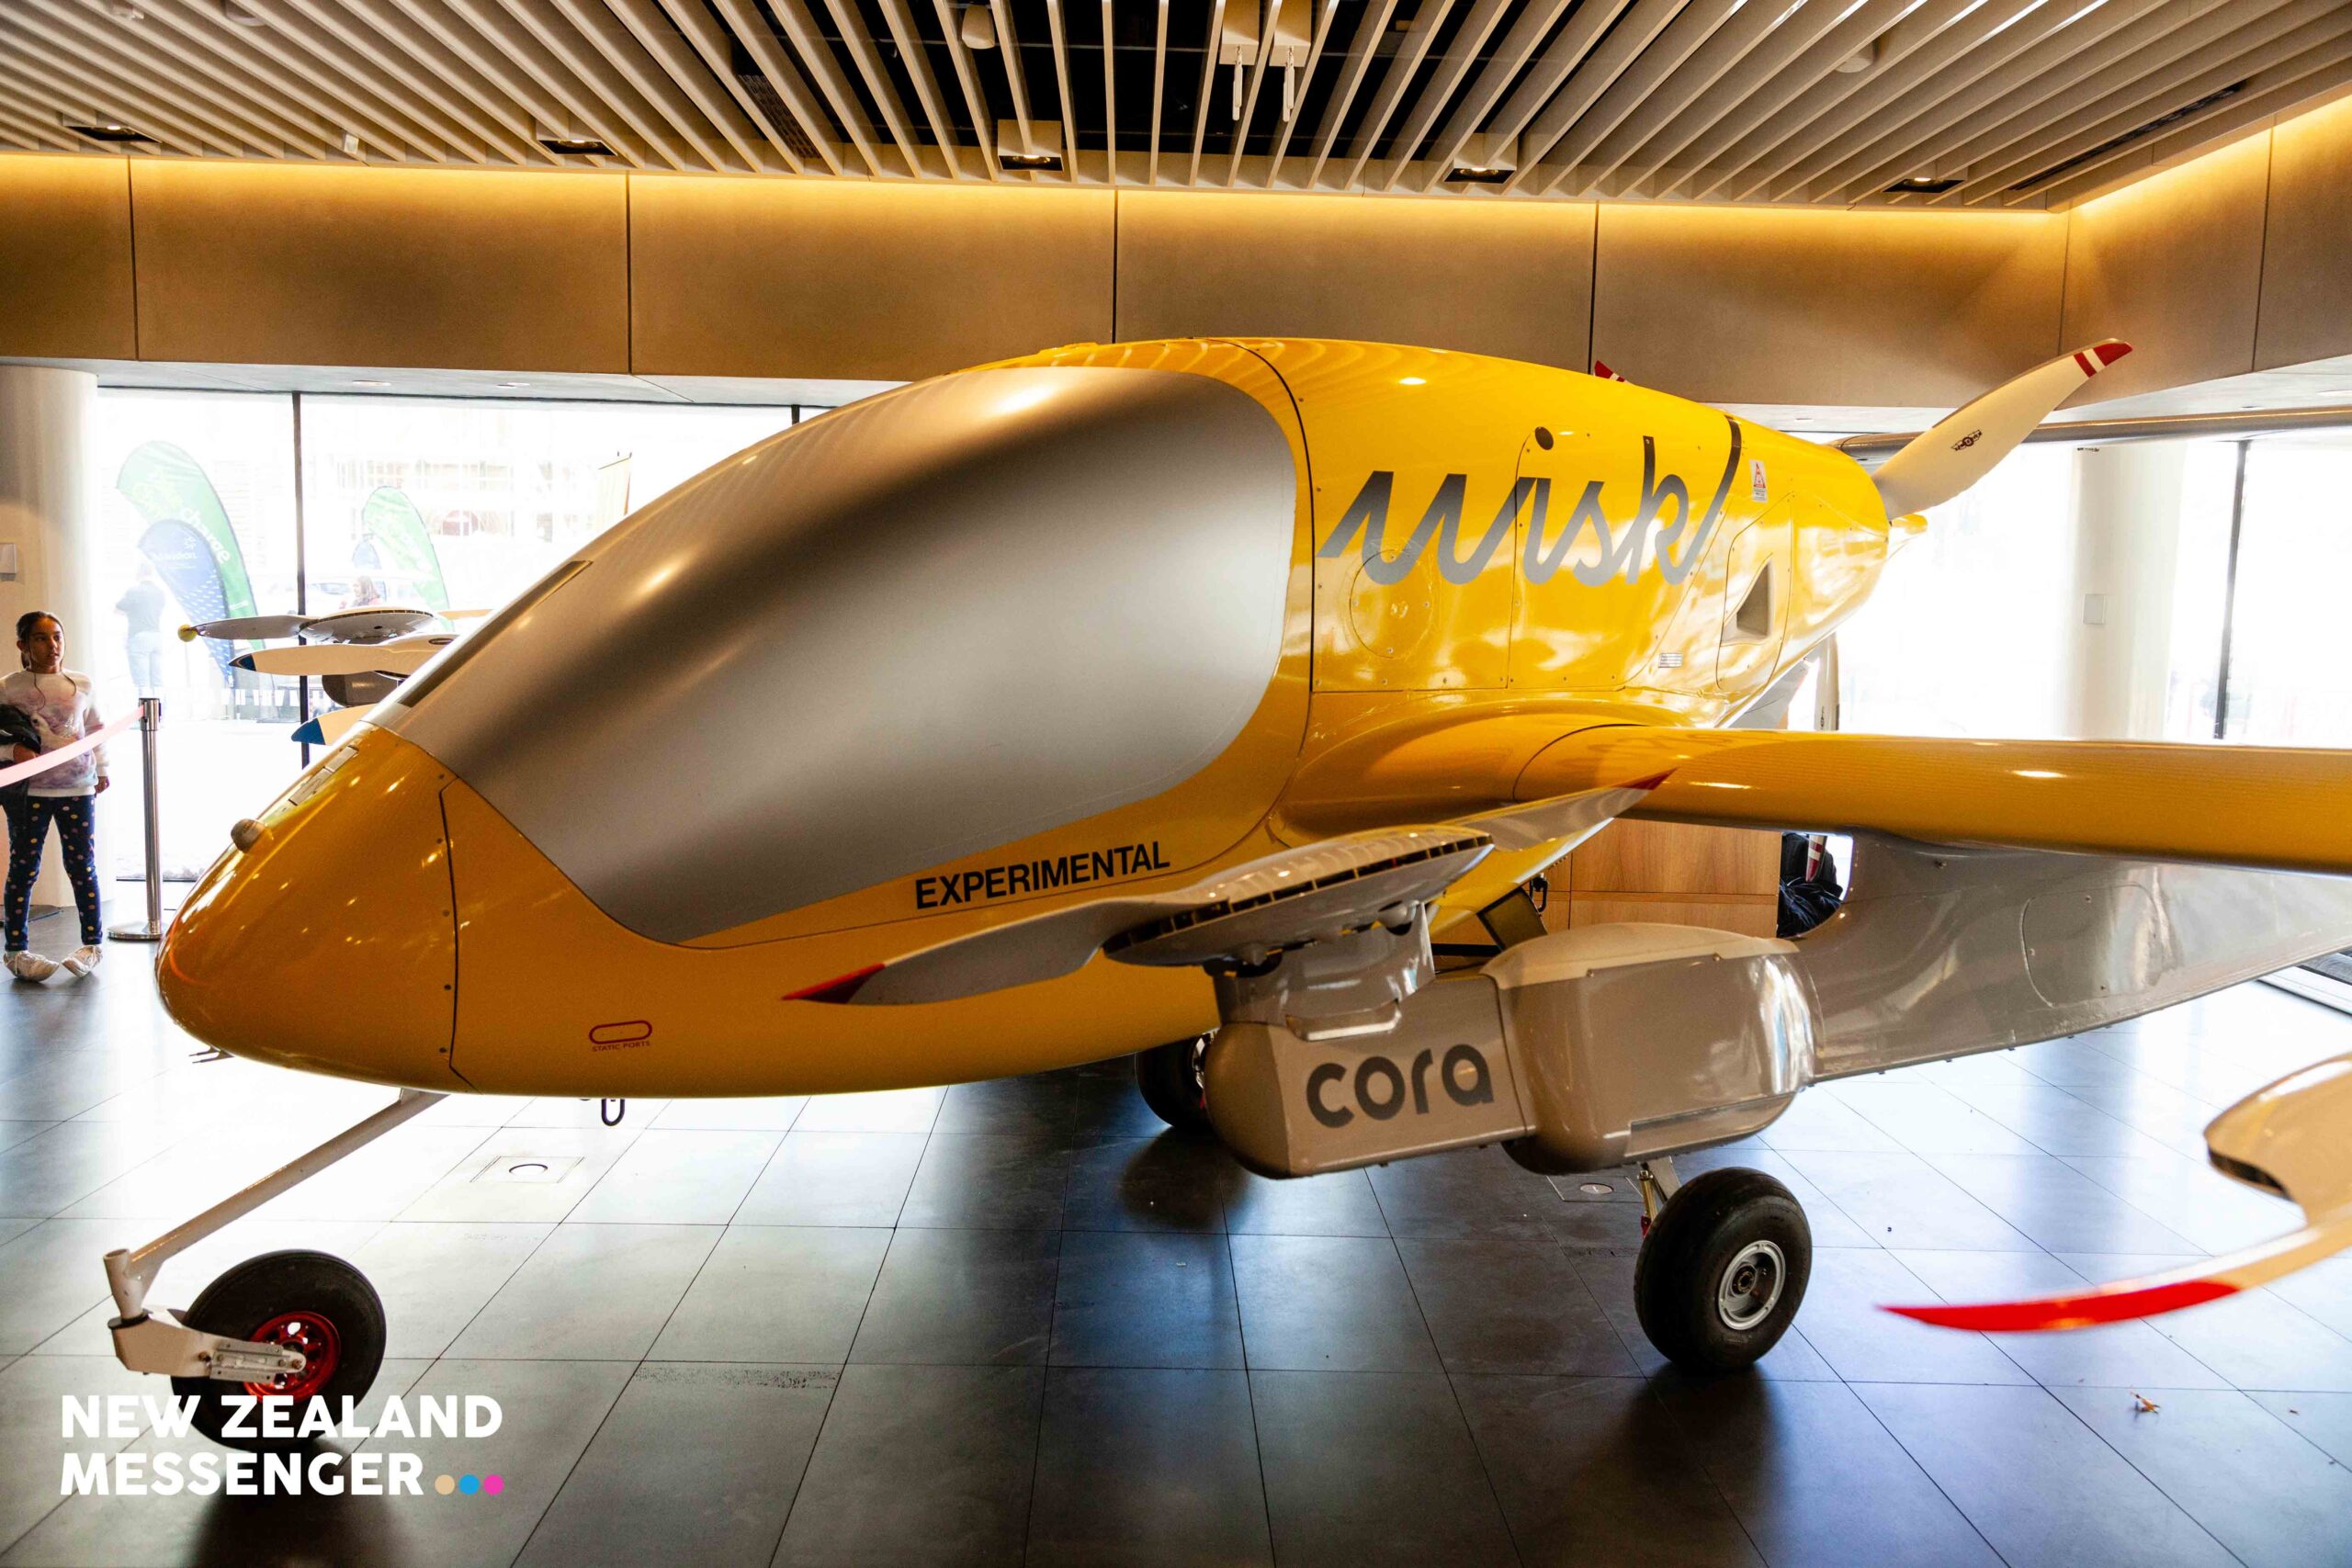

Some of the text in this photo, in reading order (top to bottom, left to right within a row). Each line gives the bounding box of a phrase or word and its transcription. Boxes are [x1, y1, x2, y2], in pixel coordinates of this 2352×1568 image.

[1316, 414, 1742, 587] wisk
[916, 841, 1170, 909] EXPERIMENTAL
[593, 1040, 650, 1052] STATIC PORTS
[1306, 1043, 1495, 1129] cora
